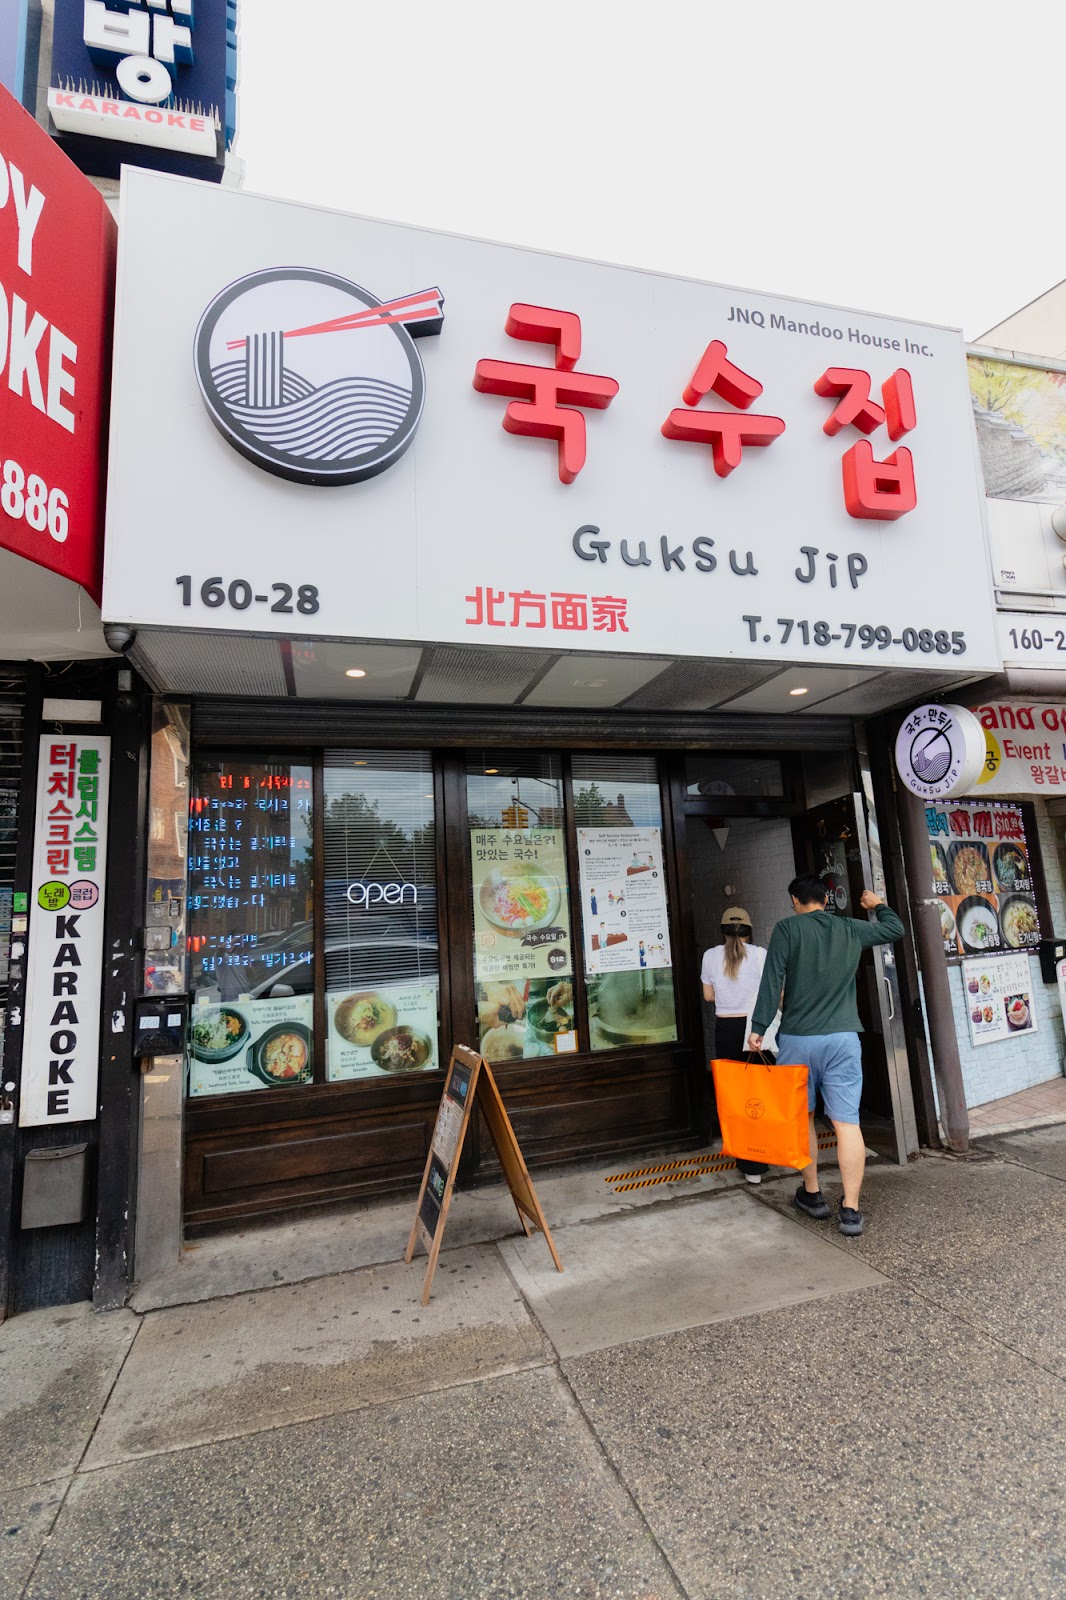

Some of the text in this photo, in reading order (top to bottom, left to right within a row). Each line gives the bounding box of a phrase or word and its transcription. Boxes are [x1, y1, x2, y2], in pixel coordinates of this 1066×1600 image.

[83, 0, 195, 103] 방
[55, 92, 206, 132] KARAOKE
[727, 306, 934, 357] JNQ Mandoo House Inc.
[473, 303, 917, 520] 국수집
[0, 459, 69, 543] 886
[176, 575, 320, 614] 160-28
[465, 586, 629, 633] 北方面家
[1003, 740, 1051, 760] Event
[46, 743, 77, 875] 터치스크린
[996, 816, 1019, 832] $10.99
[476, 834, 556, 846] 매주 수요일은?!
[476, 848, 538, 861] 맛있는 국수!
[347, 883, 417, 909] open
[540, 933, 557, 941] 수요일
[46, 915, 81, 1116] KARAOKE
